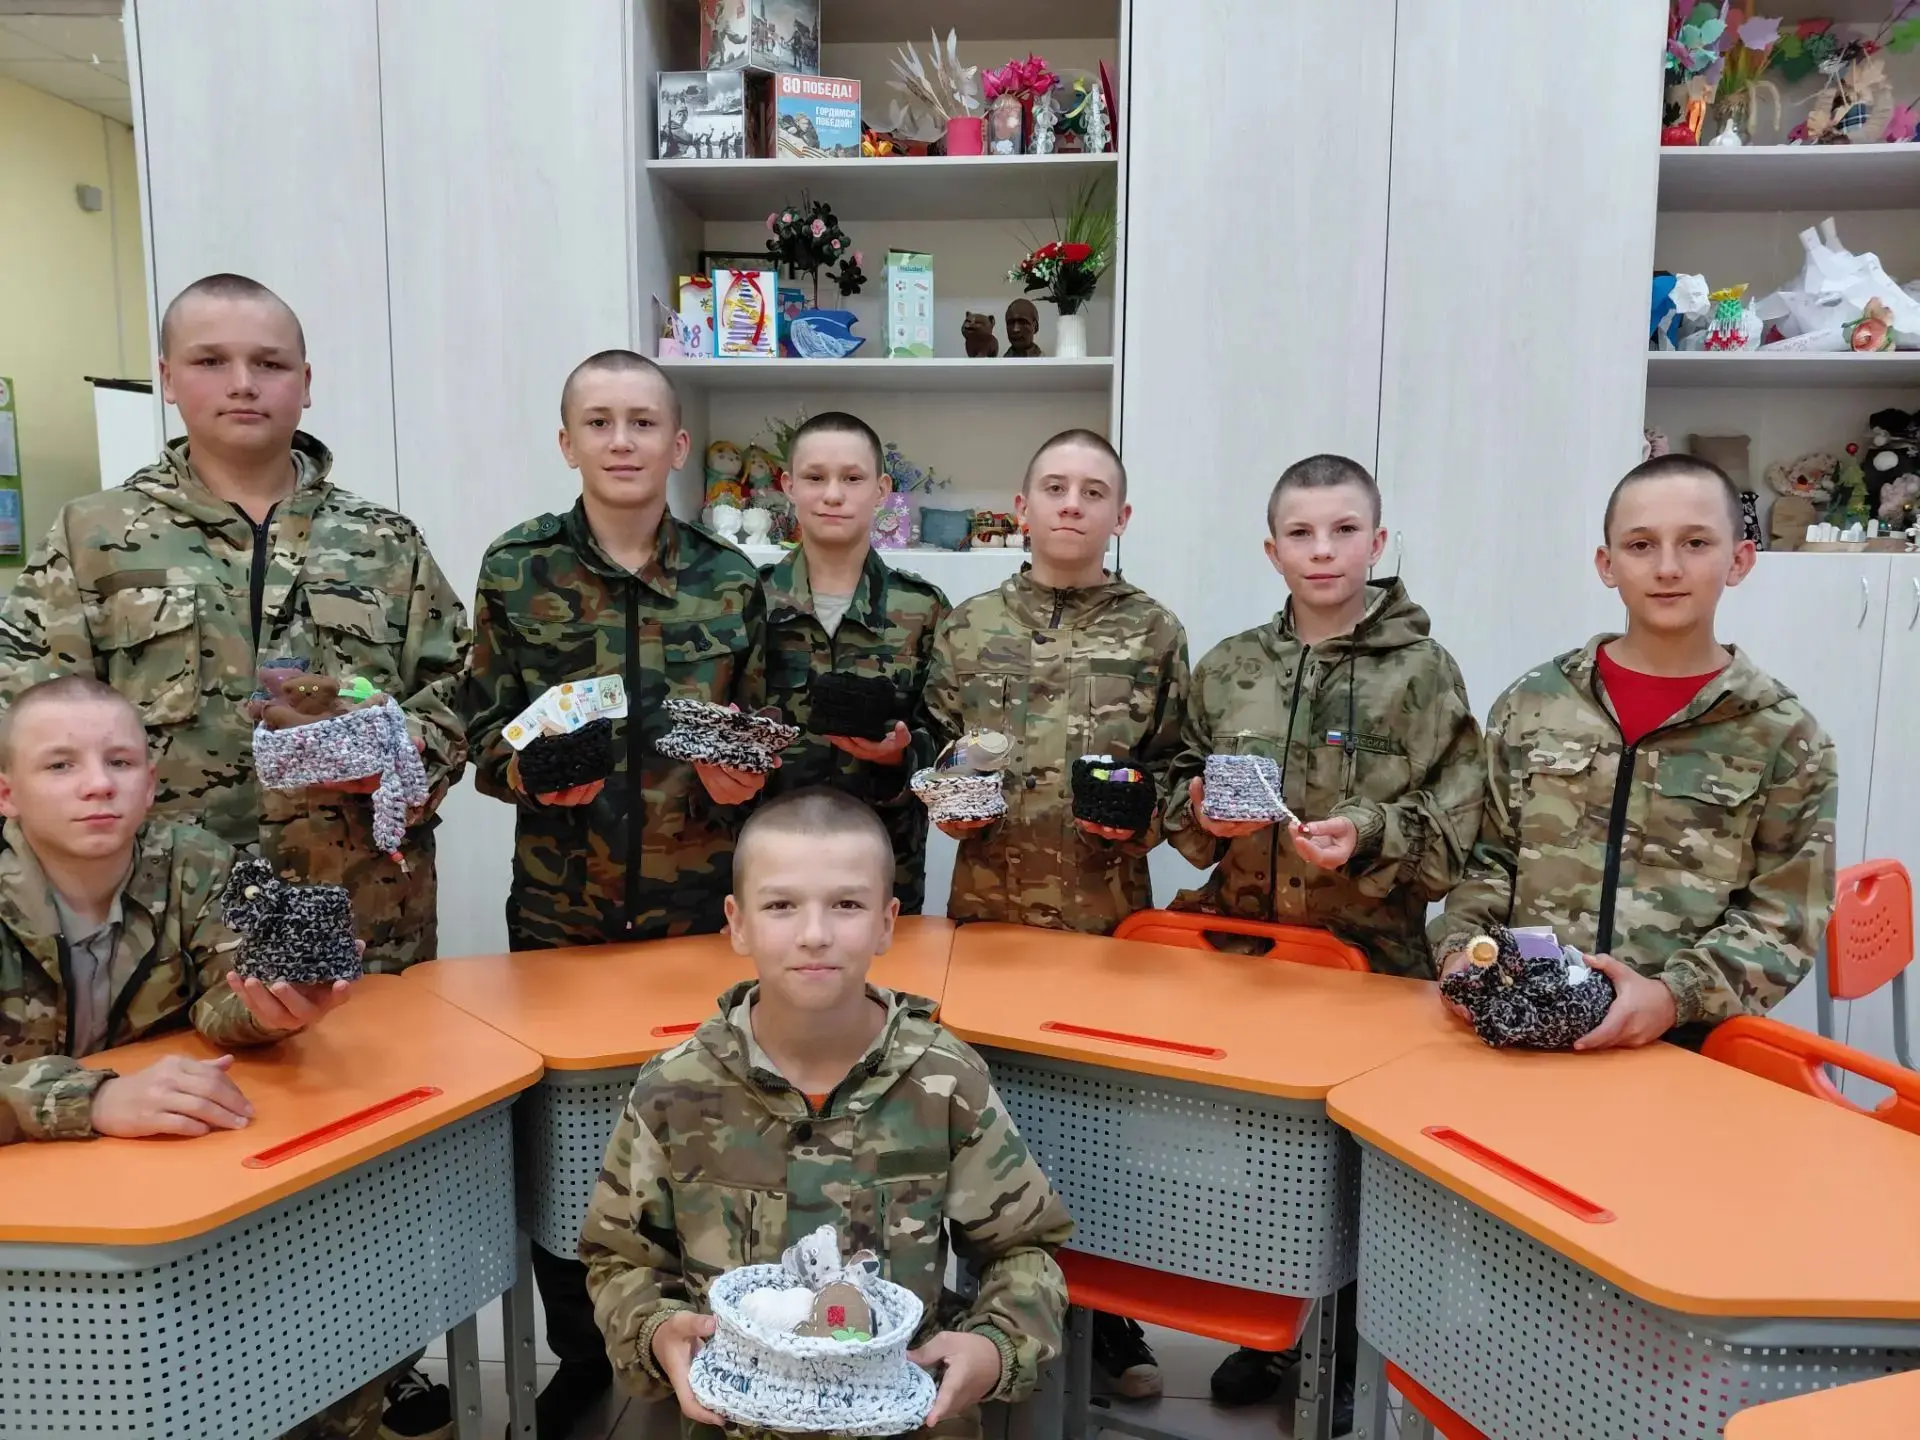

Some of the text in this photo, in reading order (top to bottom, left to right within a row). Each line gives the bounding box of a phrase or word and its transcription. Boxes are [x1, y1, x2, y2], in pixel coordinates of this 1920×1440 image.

[782, 76, 852, 99] 80 ПОБЕДА!
[815, 105, 856, 119] ГОРДИМСЯ
[815, 116, 853, 129] ПОБЕДОЙ!
[690, 324, 701, 348] 8
